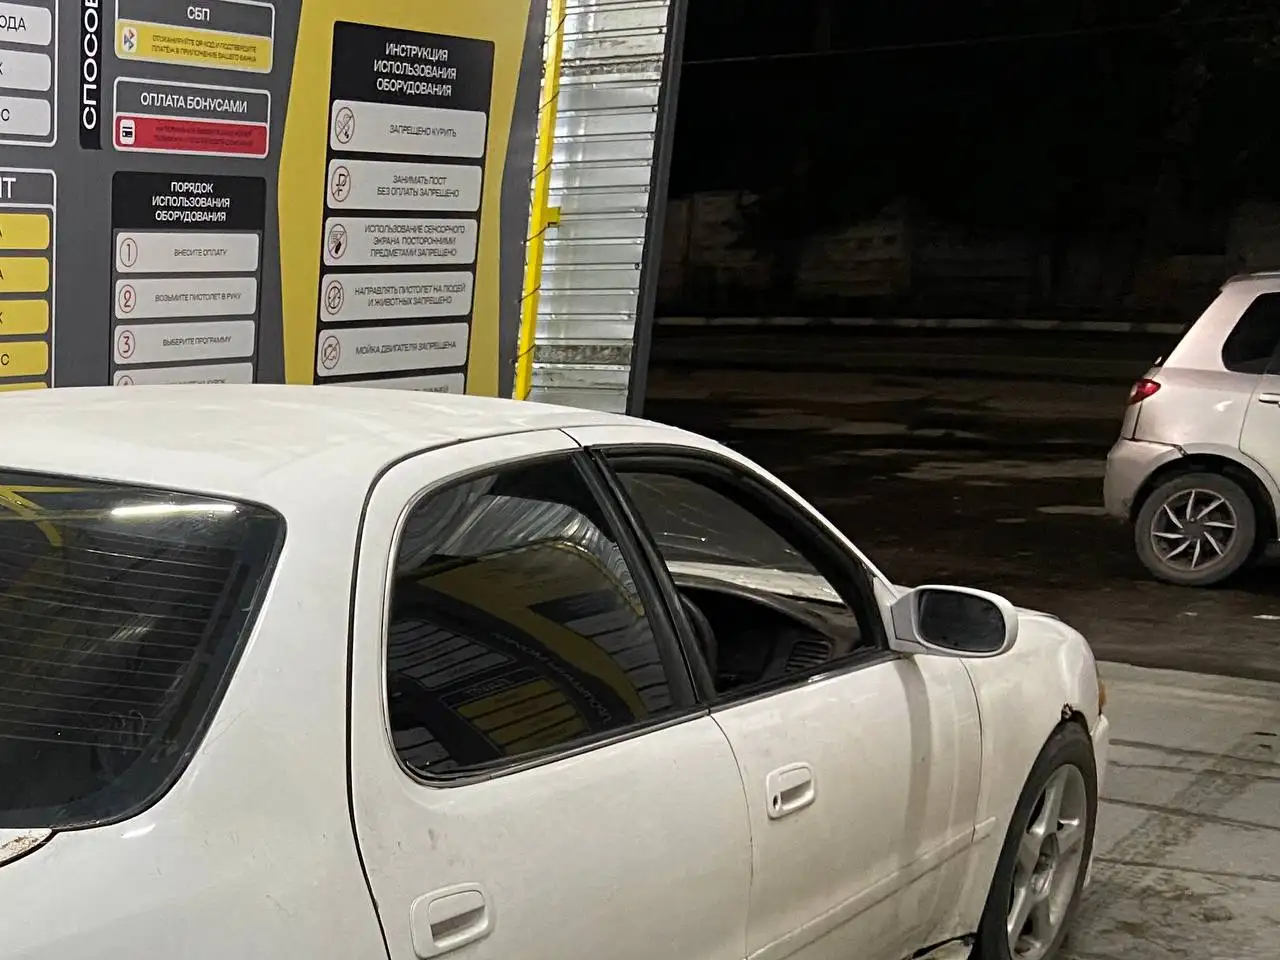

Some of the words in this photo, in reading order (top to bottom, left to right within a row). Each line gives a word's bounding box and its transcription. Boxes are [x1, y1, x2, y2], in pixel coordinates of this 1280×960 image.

[187, 6, 210, 21] СБП
[386, 42, 448, 62] ИНСТРУКЦИЯ
[374, 59, 457, 80] ИСПОЛЬЗОВАНИЯ
[376, 78, 452, 97] ОБОРУДОВАНИЯ
[140, 92, 185, 109] ОПЛАТА
[187, 96, 248, 114] БОНУСАМИ
[171, 182, 214, 194] ПОРЯДОК
[152, 196, 230, 208] ИСПОЛЬЗОВАНИЯ
[155, 210, 226, 223] ОБОРУДОВАНИЯ
[123, 290, 131, 308] 2
[123, 336, 130, 353] 3
